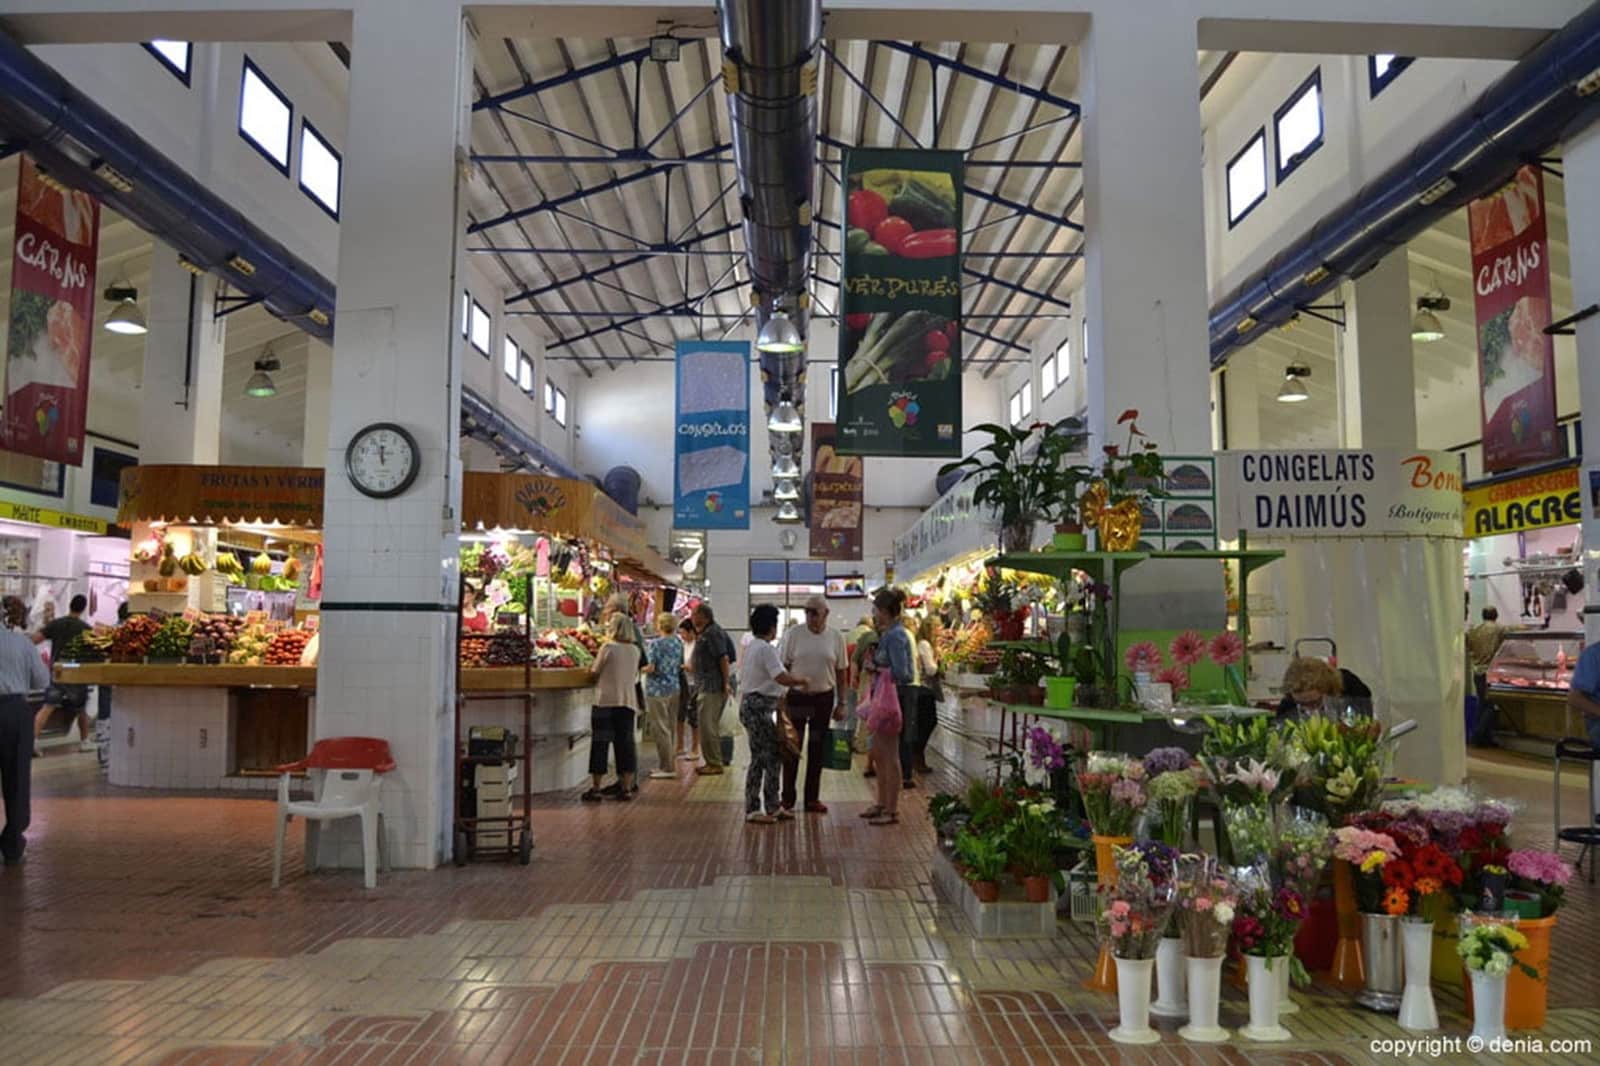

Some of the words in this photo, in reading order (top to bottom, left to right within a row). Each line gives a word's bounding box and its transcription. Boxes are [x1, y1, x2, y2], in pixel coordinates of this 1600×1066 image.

[1477, 241, 1541, 296] CARNS
[200, 472, 258, 488] FRUTAS
[1242, 453, 1375, 482] CONGELATS
[1255, 486, 1367, 529] DAIMÚS
